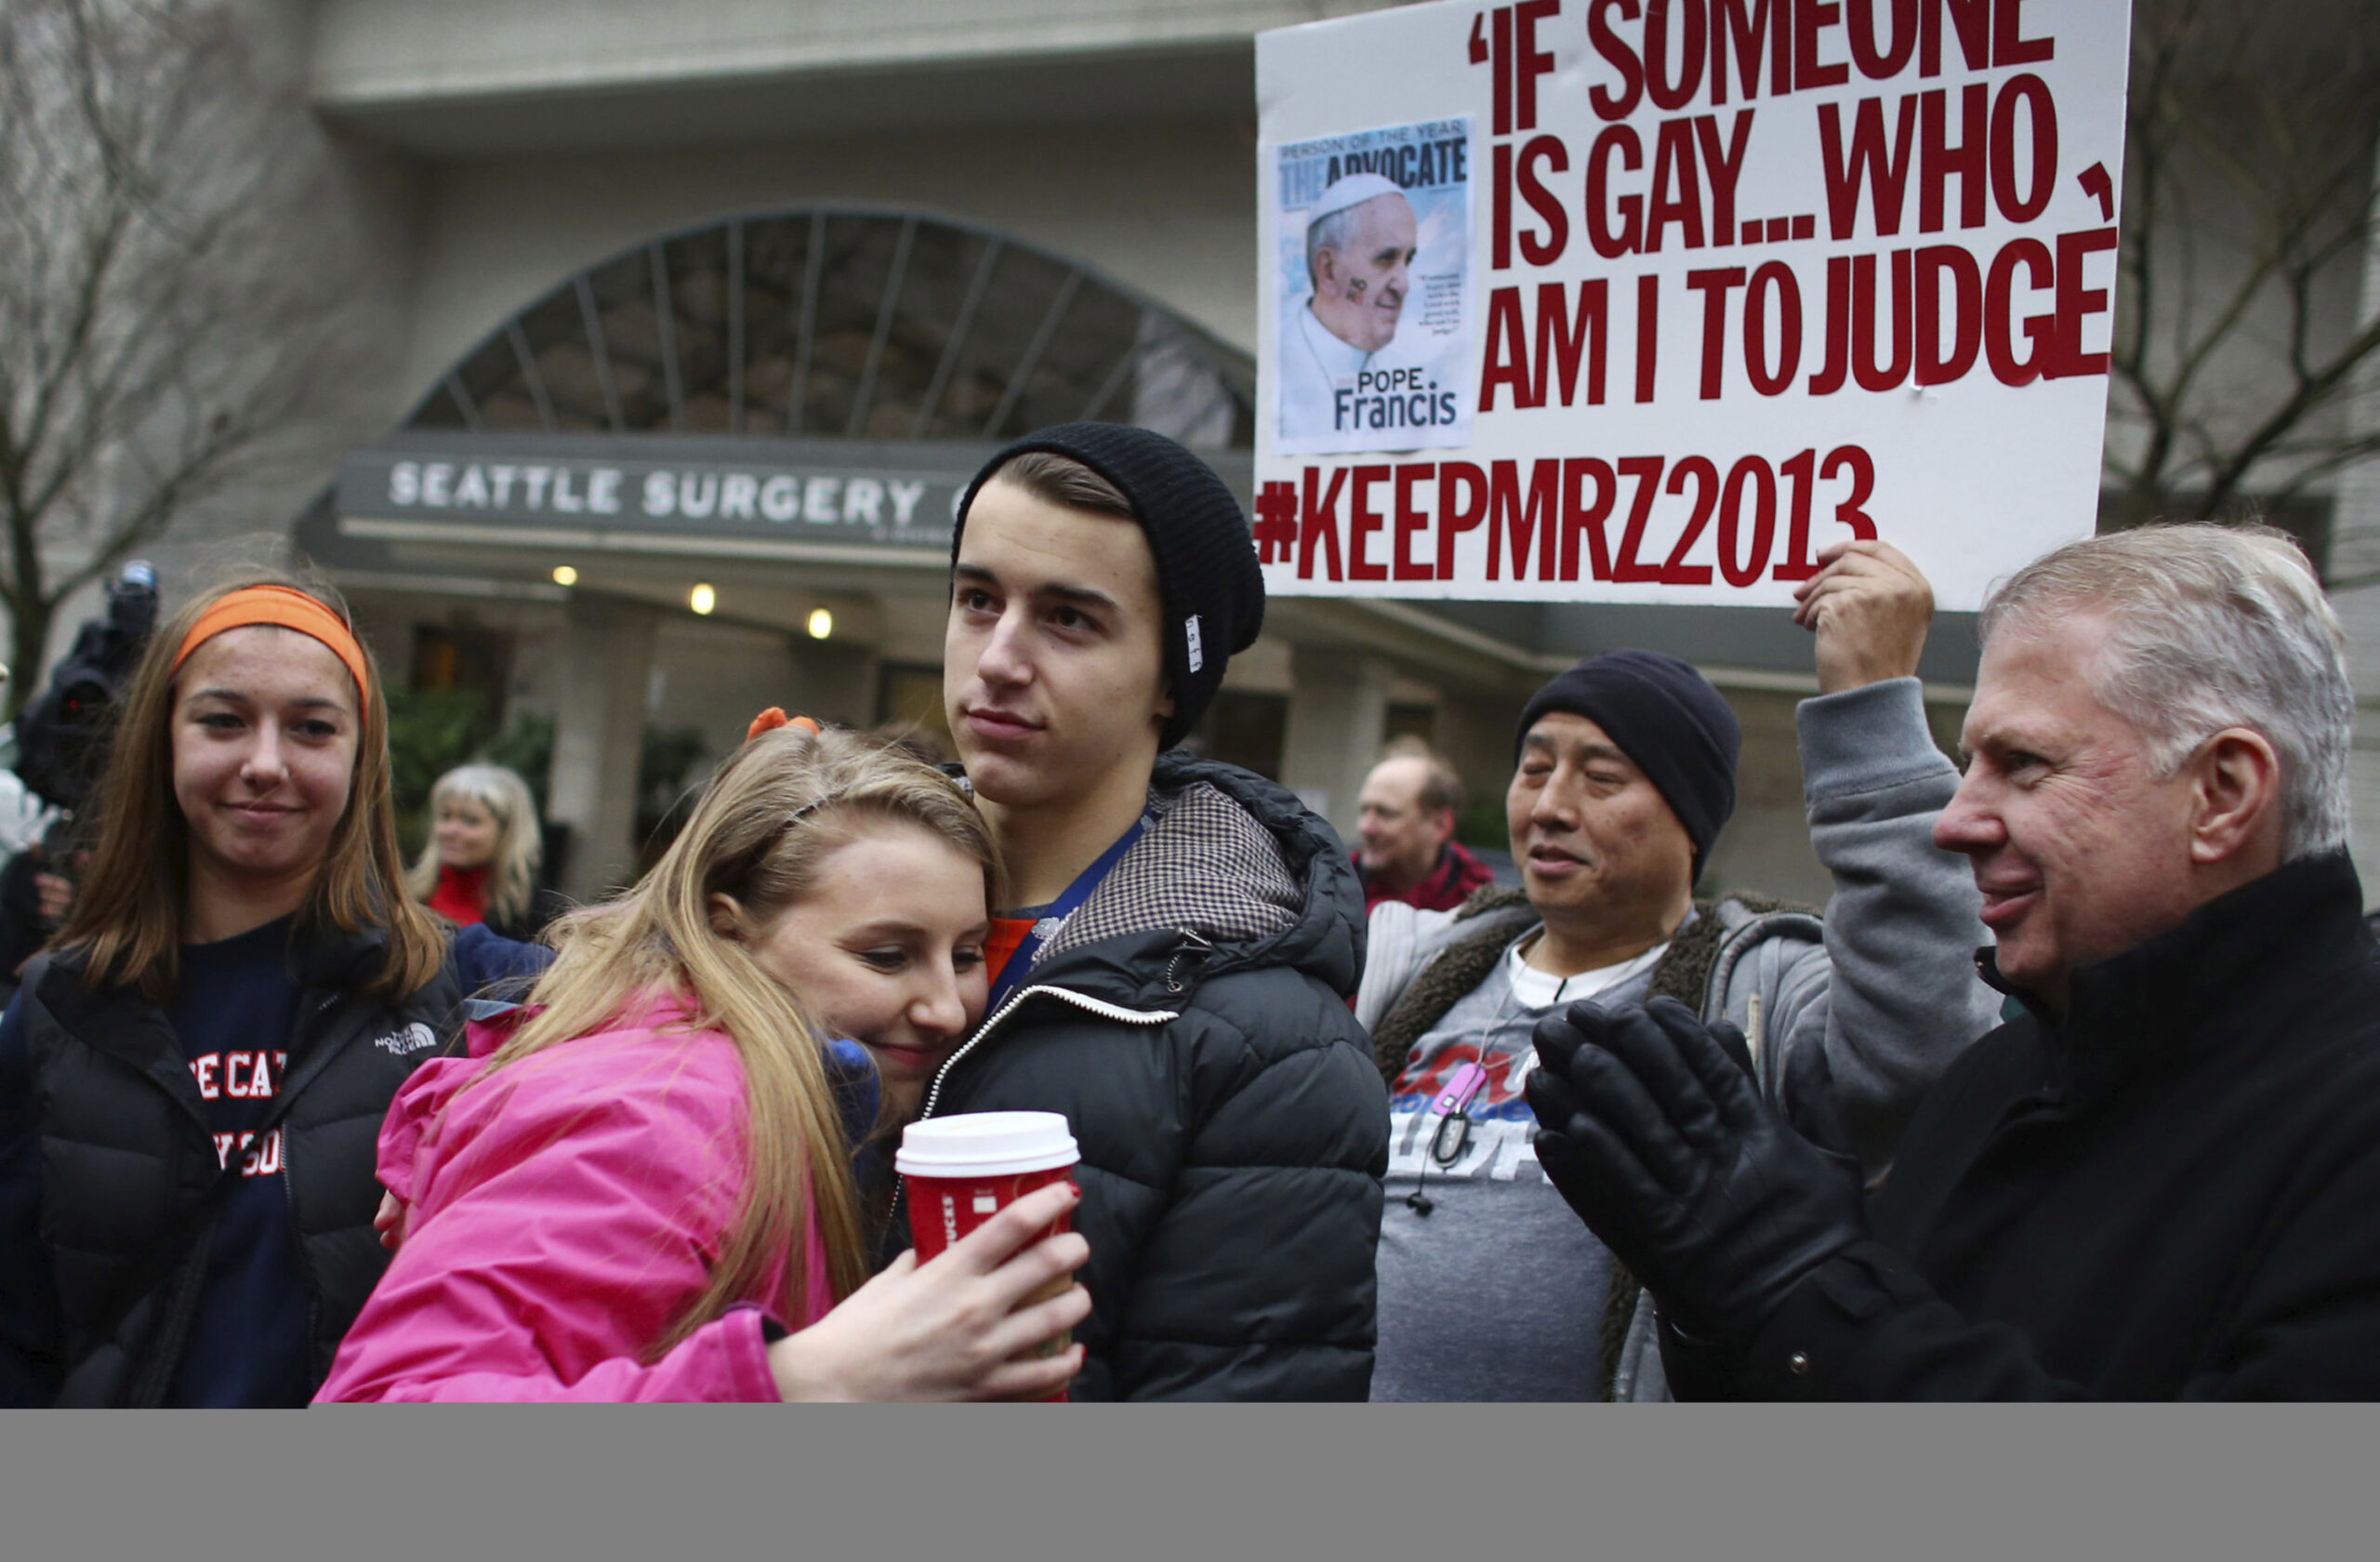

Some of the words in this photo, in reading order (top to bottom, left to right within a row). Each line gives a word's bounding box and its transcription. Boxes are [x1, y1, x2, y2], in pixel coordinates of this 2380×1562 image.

[1281, 137, 1344, 159] PERSON
[1351, 133, 1369, 147] OF
[1378, 126, 1409, 141] THE
[1417, 119, 1463, 139] YEAR
[1326, 137, 1467, 189] ADVOCATE
[1492, 134, 1568, 271] IS
[1478, 278, 1608, 413] AM
[1634, 273, 1659, 404] I
[1686, 259, 1803, 398] TO
[1335, 381, 1457, 430] Francis
[1358, 367, 1423, 393] POPE
[389, 461, 622, 514] SEATTLE
[642, 470, 924, 526] SURGERY
[1253, 444, 1878, 588] #KEEPMRZ2013
[188, 1052, 221, 1101] E
